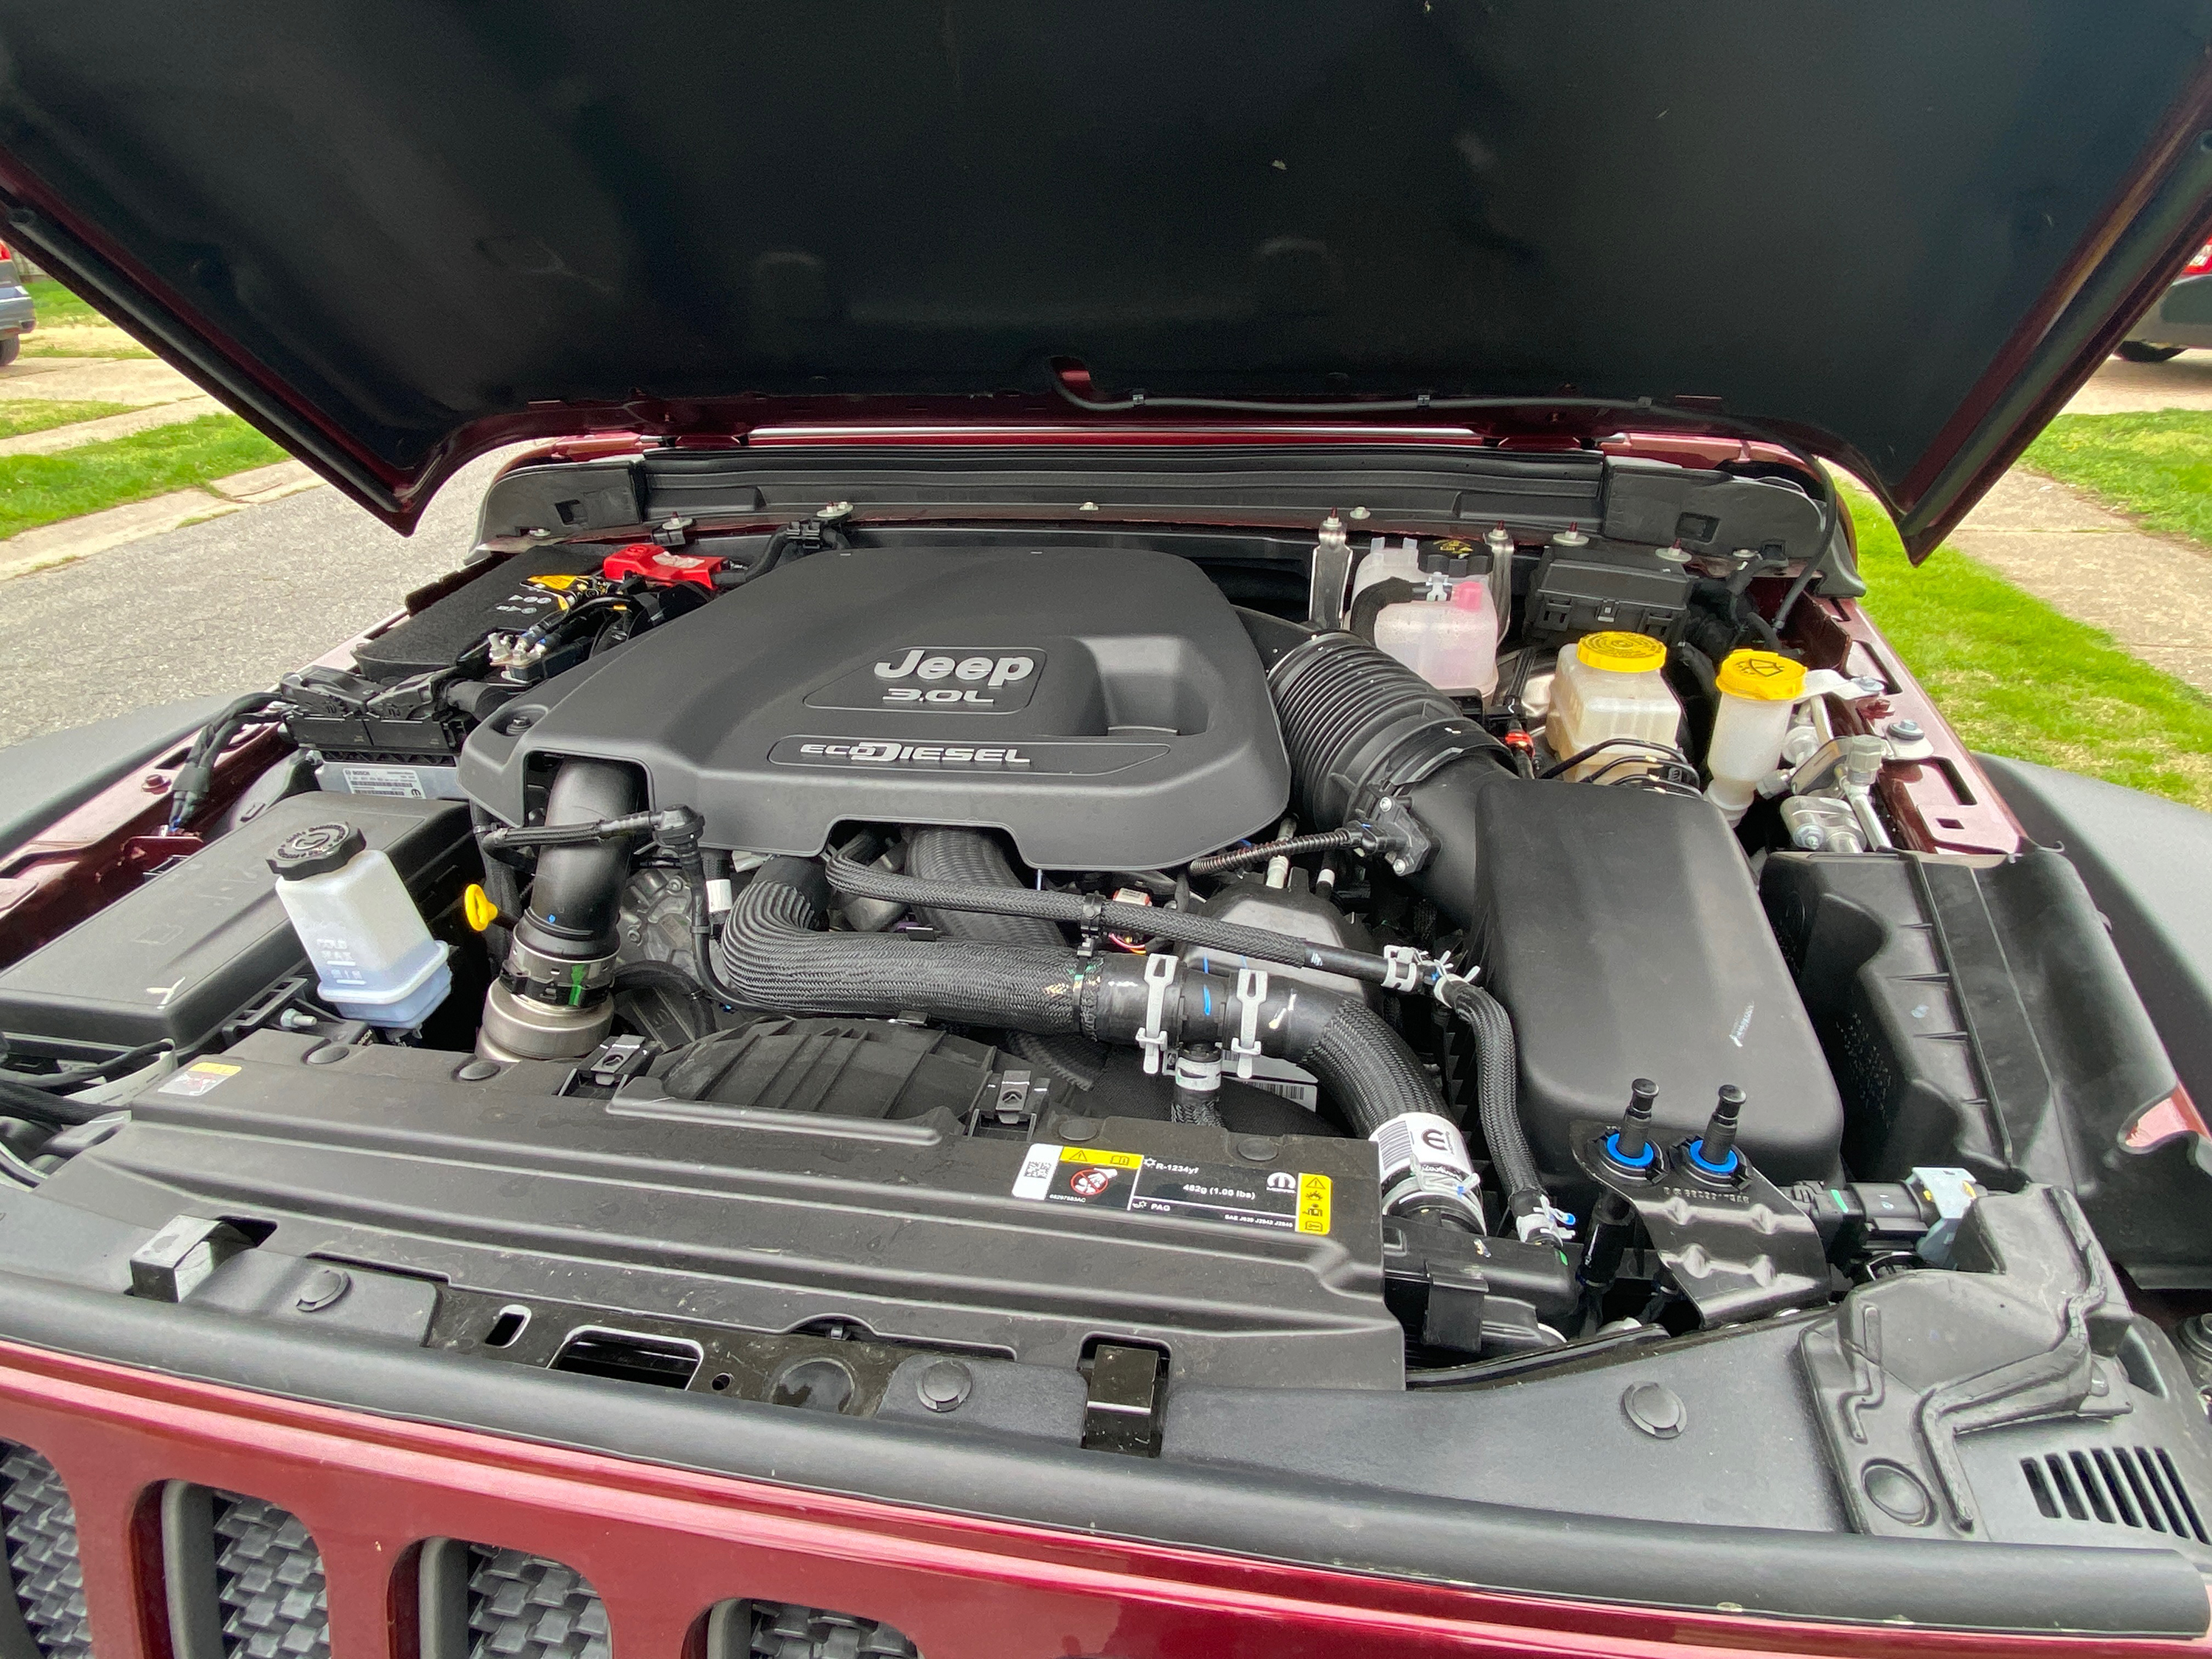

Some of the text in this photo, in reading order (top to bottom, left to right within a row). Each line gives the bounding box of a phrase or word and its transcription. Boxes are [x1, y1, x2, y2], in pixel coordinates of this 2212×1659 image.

[874, 650, 1034, 687] Jeep
[882, 688, 995, 704] 3.0L
[1155, 1163, 1200, 1175] R-1234yf
[1150, 1203, 1171, 1211] PAG
